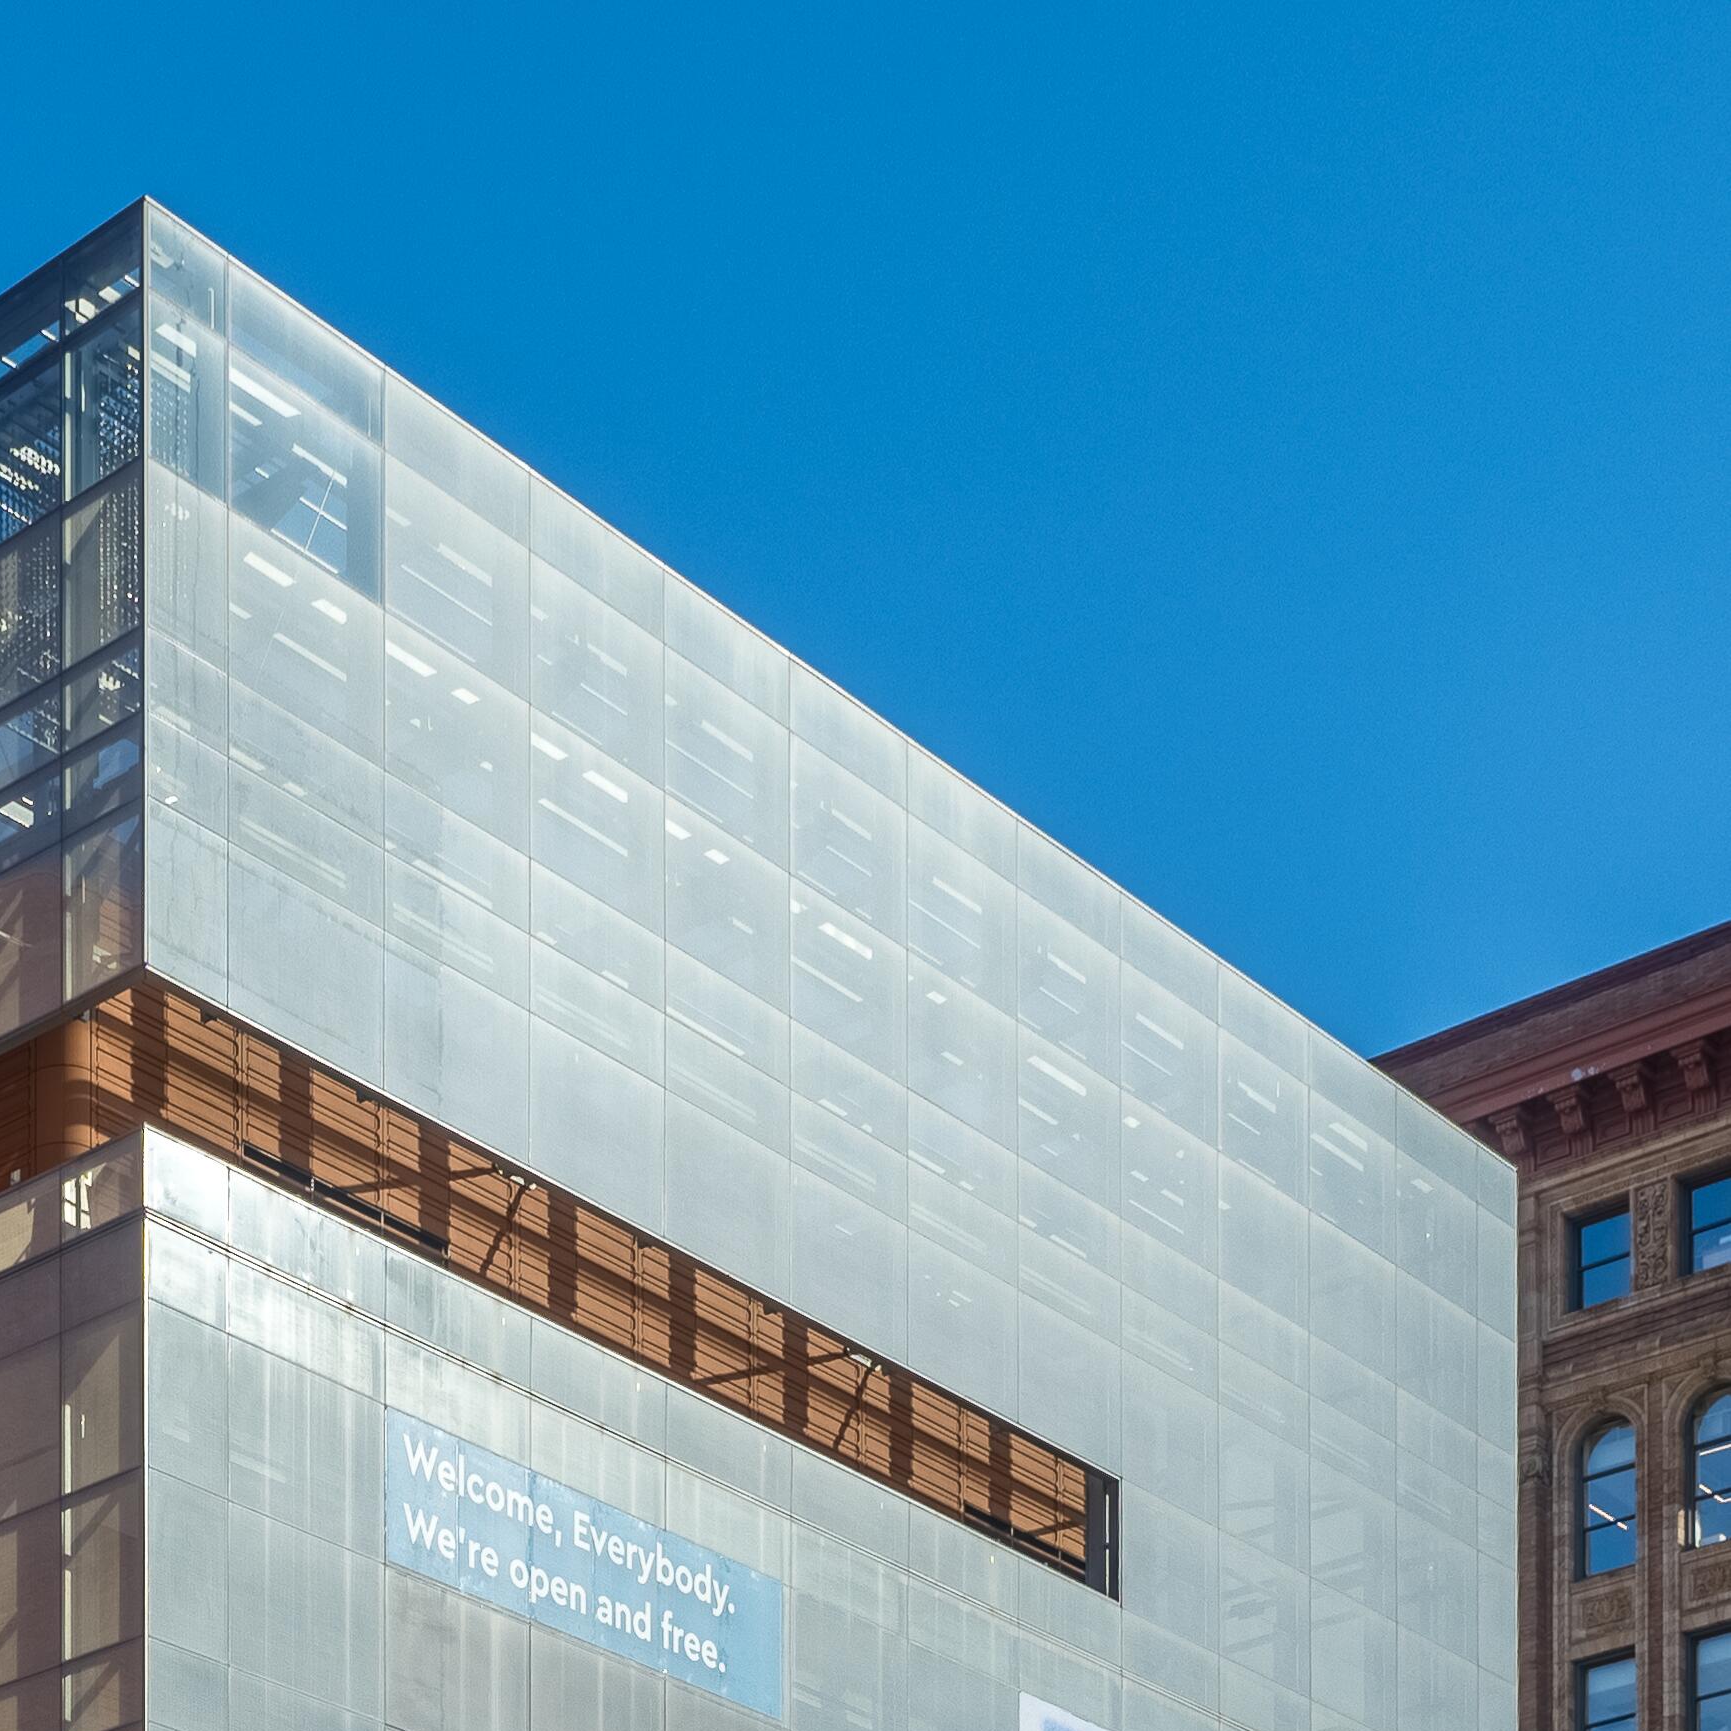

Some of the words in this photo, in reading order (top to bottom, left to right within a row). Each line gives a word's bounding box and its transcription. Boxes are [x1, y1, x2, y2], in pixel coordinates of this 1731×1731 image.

[403, 1433, 562, 1547] Welcome,
[573, 1510, 736, 1615] Everybody.
[403, 1502, 499, 1578] We're
[509, 1558, 587, 1615] open
[597, 1594, 652, 1643] and
[661, 1610, 727, 1673] free.
